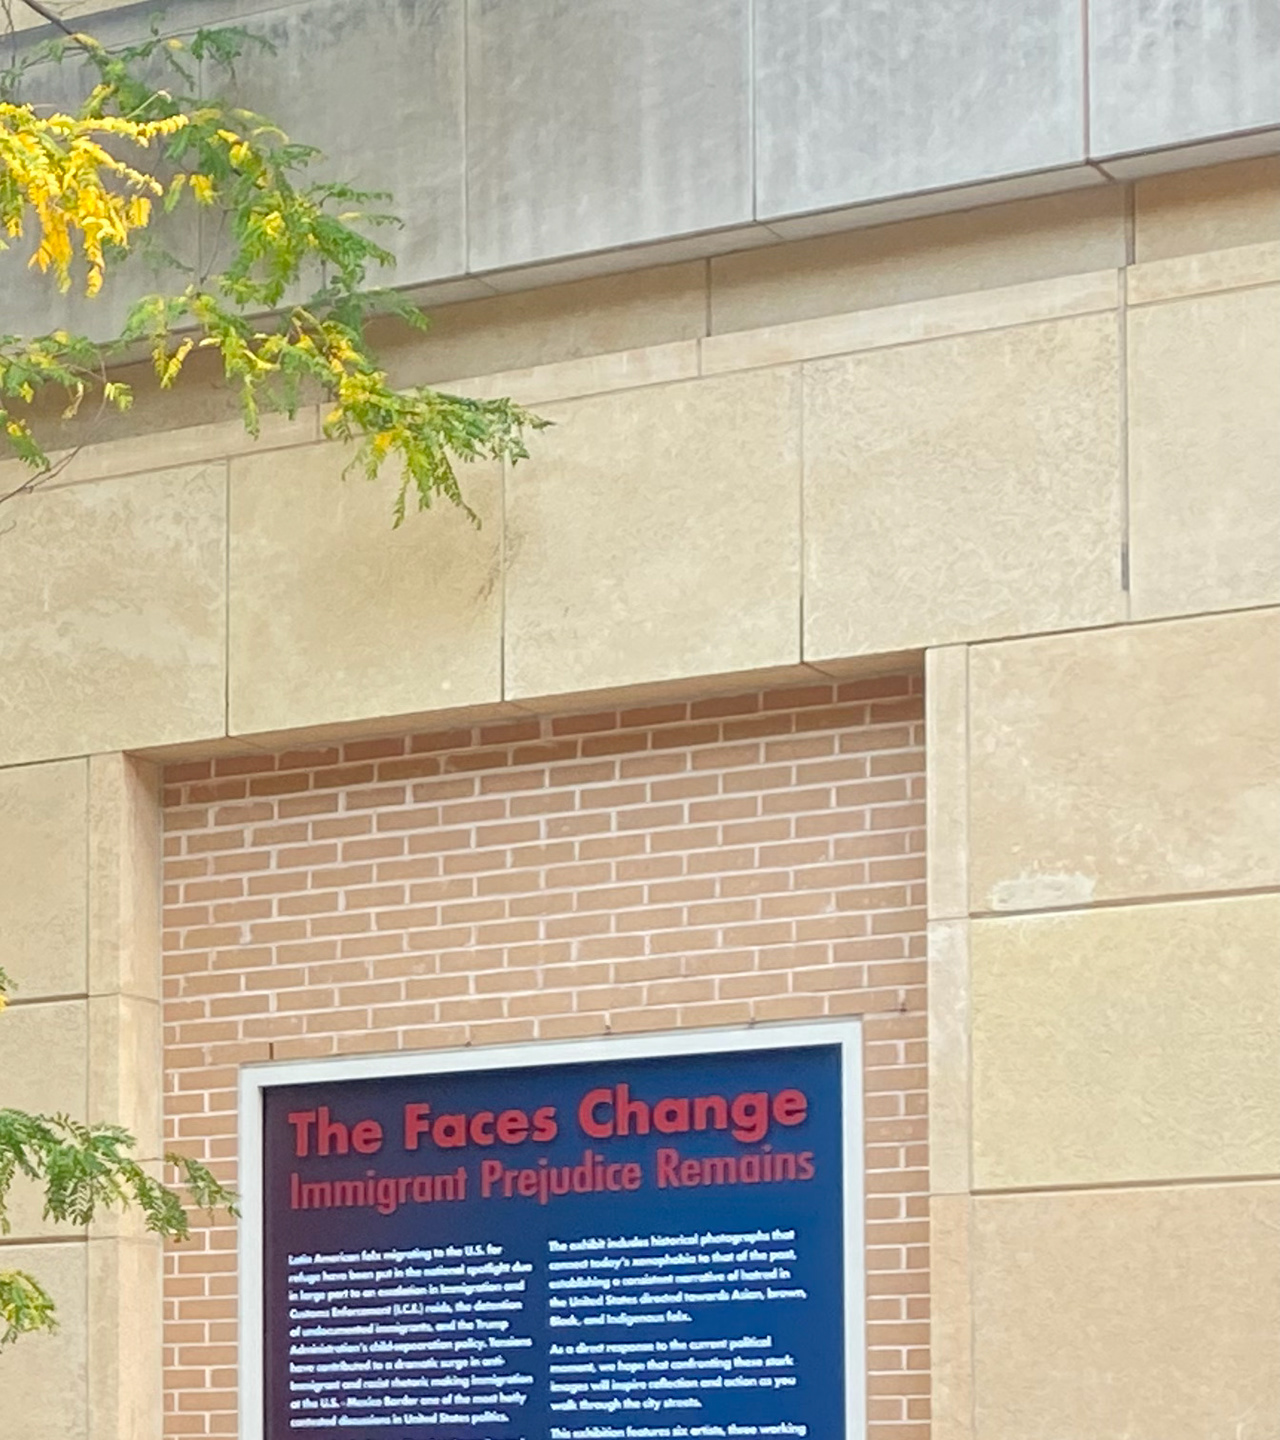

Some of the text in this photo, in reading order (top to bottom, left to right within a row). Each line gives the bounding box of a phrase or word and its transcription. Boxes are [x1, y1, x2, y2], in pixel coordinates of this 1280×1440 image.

[288, 1083, 807, 1157] The Faces Change
[291, 1144, 815, 1215] Immigrant Prejudice Remains
[549, 1229, 796, 1251] The exhibit includes historical photographs that
[314, 1251, 359, 1263] American
[569, 1294, 603, 1307] United
[606, 1294, 637, 1305] States
[550, 1375, 797, 1394] images will inspire reflection and action as you
